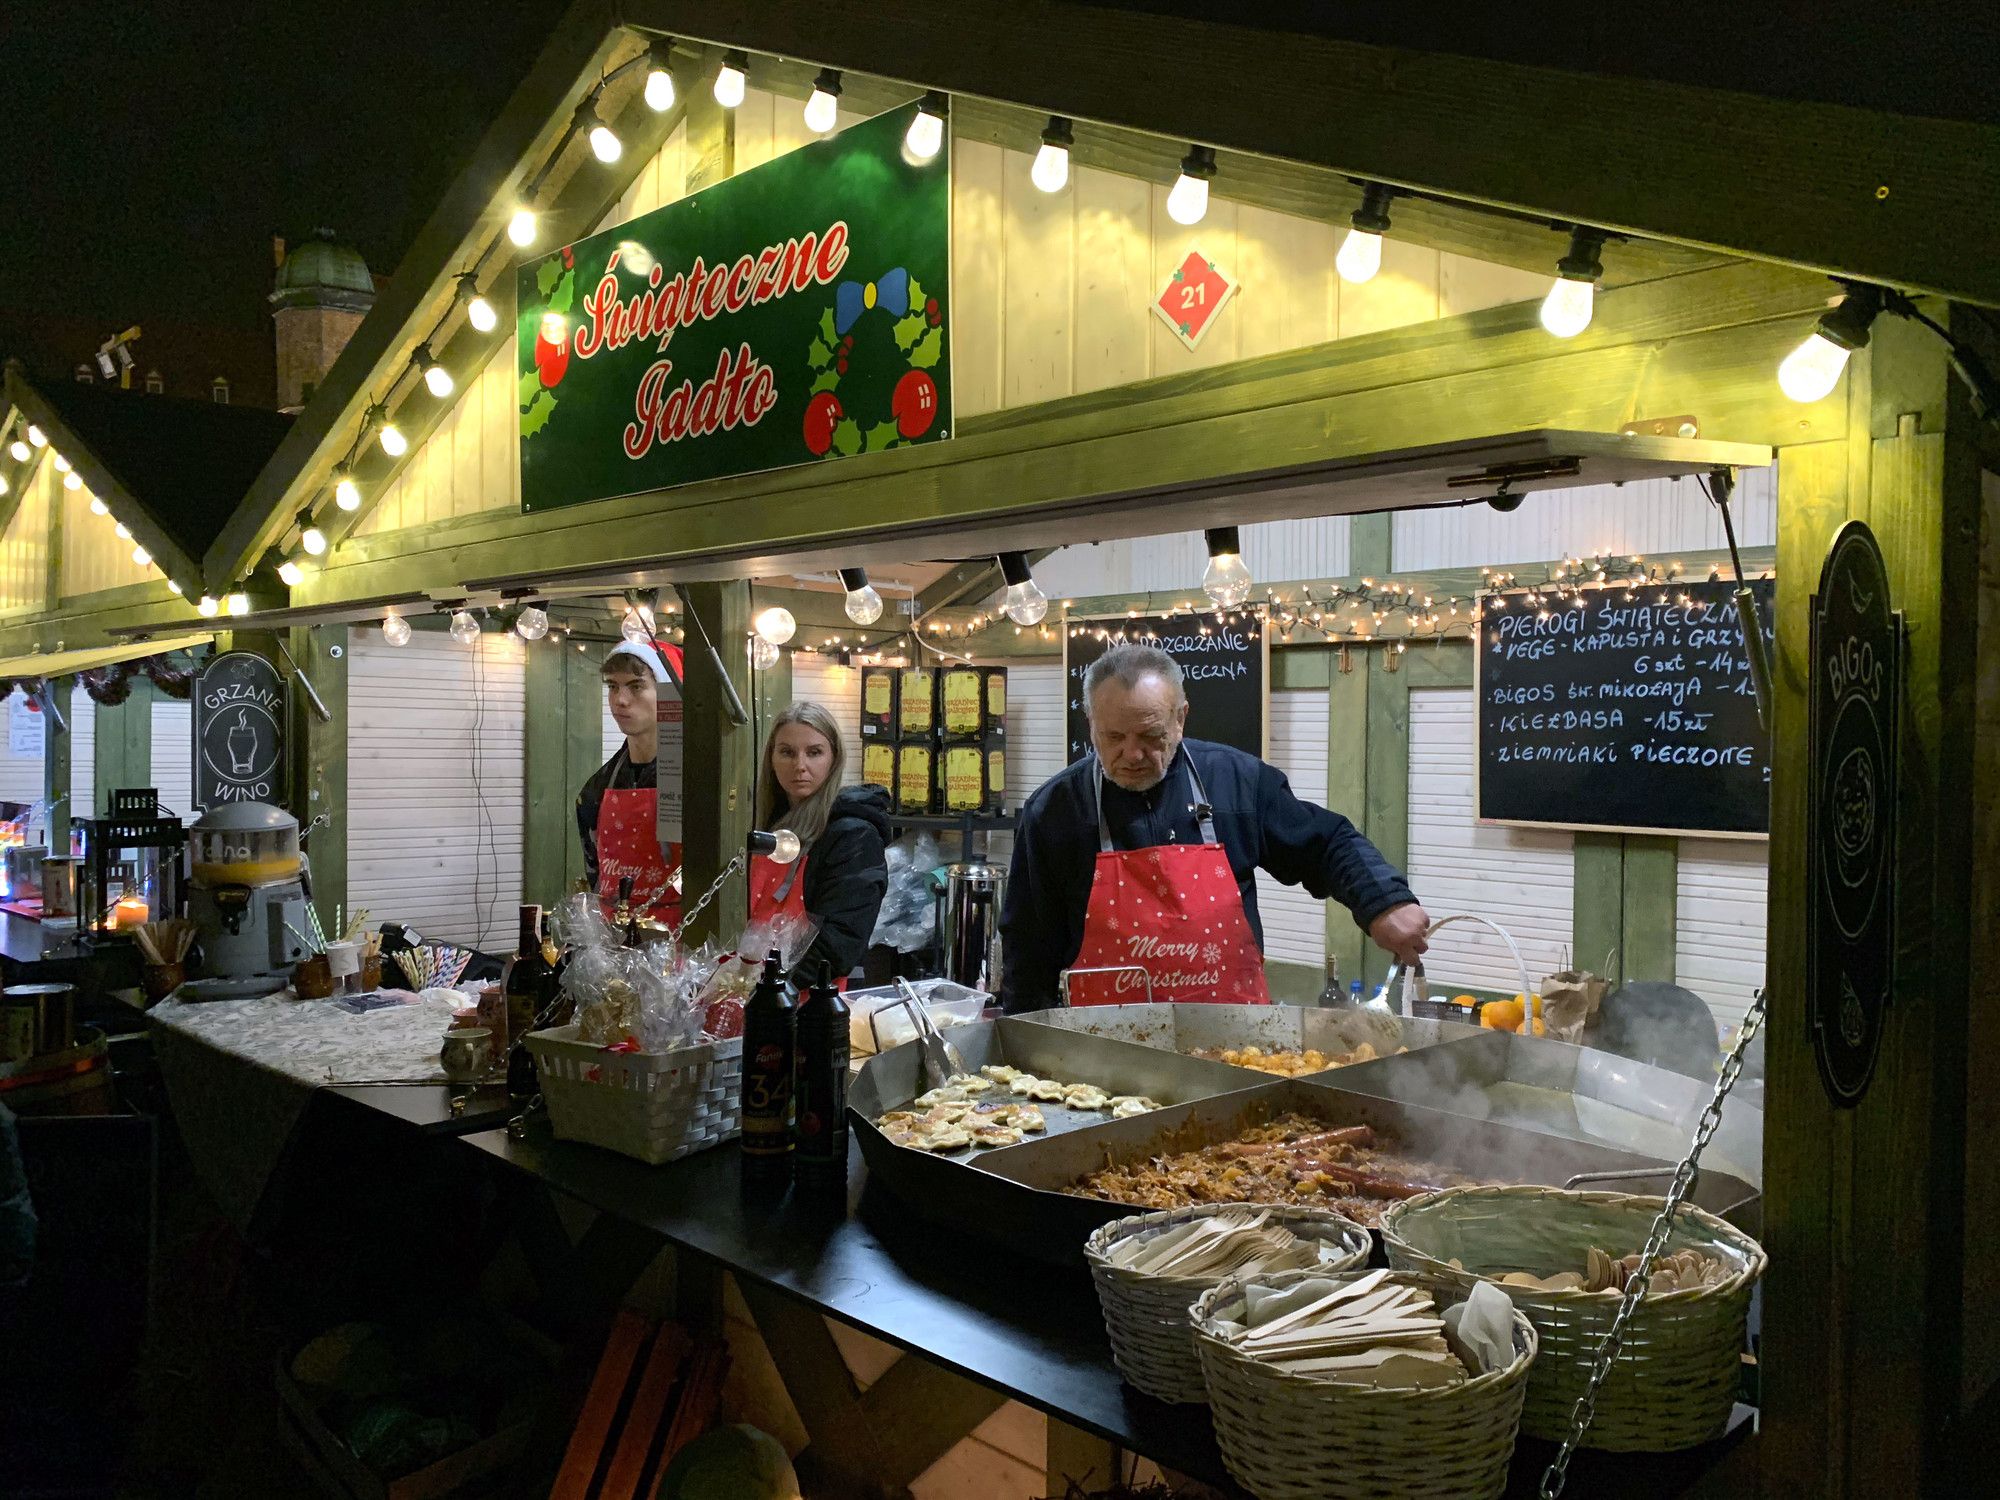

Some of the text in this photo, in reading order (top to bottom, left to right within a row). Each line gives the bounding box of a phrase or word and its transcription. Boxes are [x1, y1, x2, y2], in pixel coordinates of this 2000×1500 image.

[574, 220, 850, 360] Świąteczne
[1181, 282, 1205, 310] 21
[623, 340, 778, 460] Jadło
[1498, 597, 1760, 638] PIEROGI ŚWIĄTECZN
[1506, 639, 1556, 660] VEGE
[1573, 630, 1666, 653] KAPUSTA
[1688, 626, 1775, 648] GRZY
[1180, 661, 1248, 681] TECZNA
[1828, 635, 1884, 702] BIGOS
[204, 683, 282, 712] GRZANE
[214, 782, 270, 802] WINO
[601, 858, 643, 880] Merry
[1127, 935, 1200, 963] Merry
